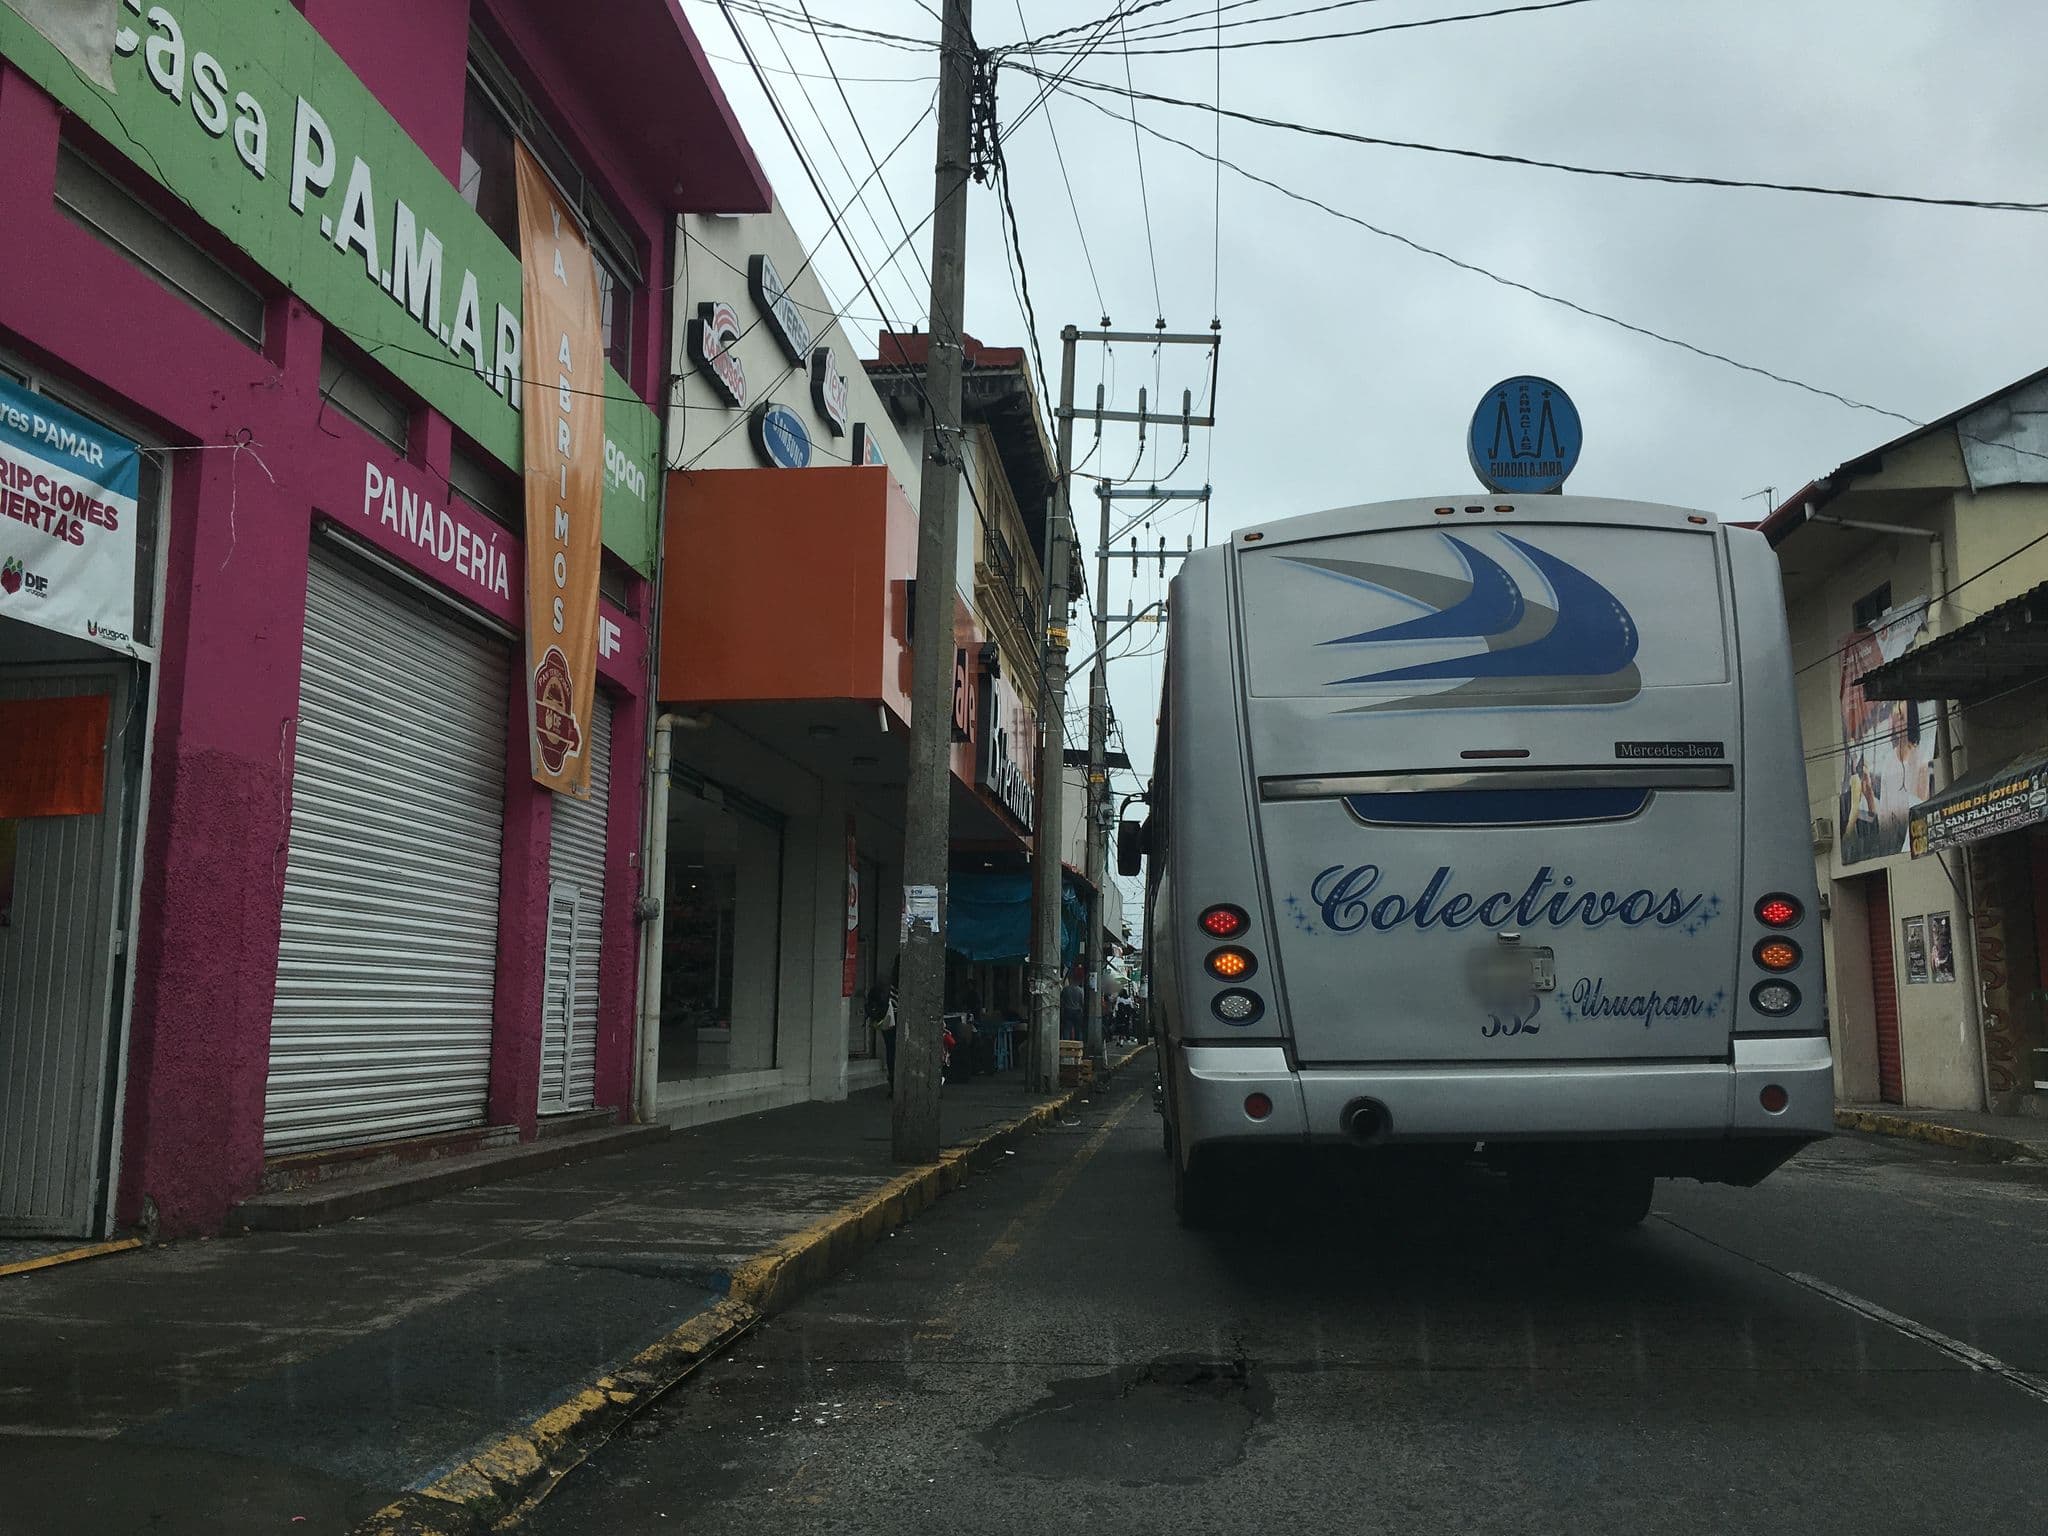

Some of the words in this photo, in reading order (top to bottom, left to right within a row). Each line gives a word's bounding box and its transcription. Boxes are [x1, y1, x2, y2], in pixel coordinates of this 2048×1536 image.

[550, 203, 568, 288] YA
[32, 414, 105, 468] PAMAR
[552, 332, 574, 635] ABRIMOS
[603, 434, 646, 502] apan
[1490, 460, 1563, 479] GUADALAJARA
[363, 461, 510, 601] PANADERÍA
[24, 571, 49, 592] DIF
[1620, 744, 1720, 757] Mercedes-Benz
[1945, 813, 1965, 828] SAN
[1967, 793, 2028, 821] FRANCISCO
[1973, 794, 1986, 806] DE
[1311, 864, 1702, 932] Colectivos
[1572, 977, 1704, 1027] Uruapan
